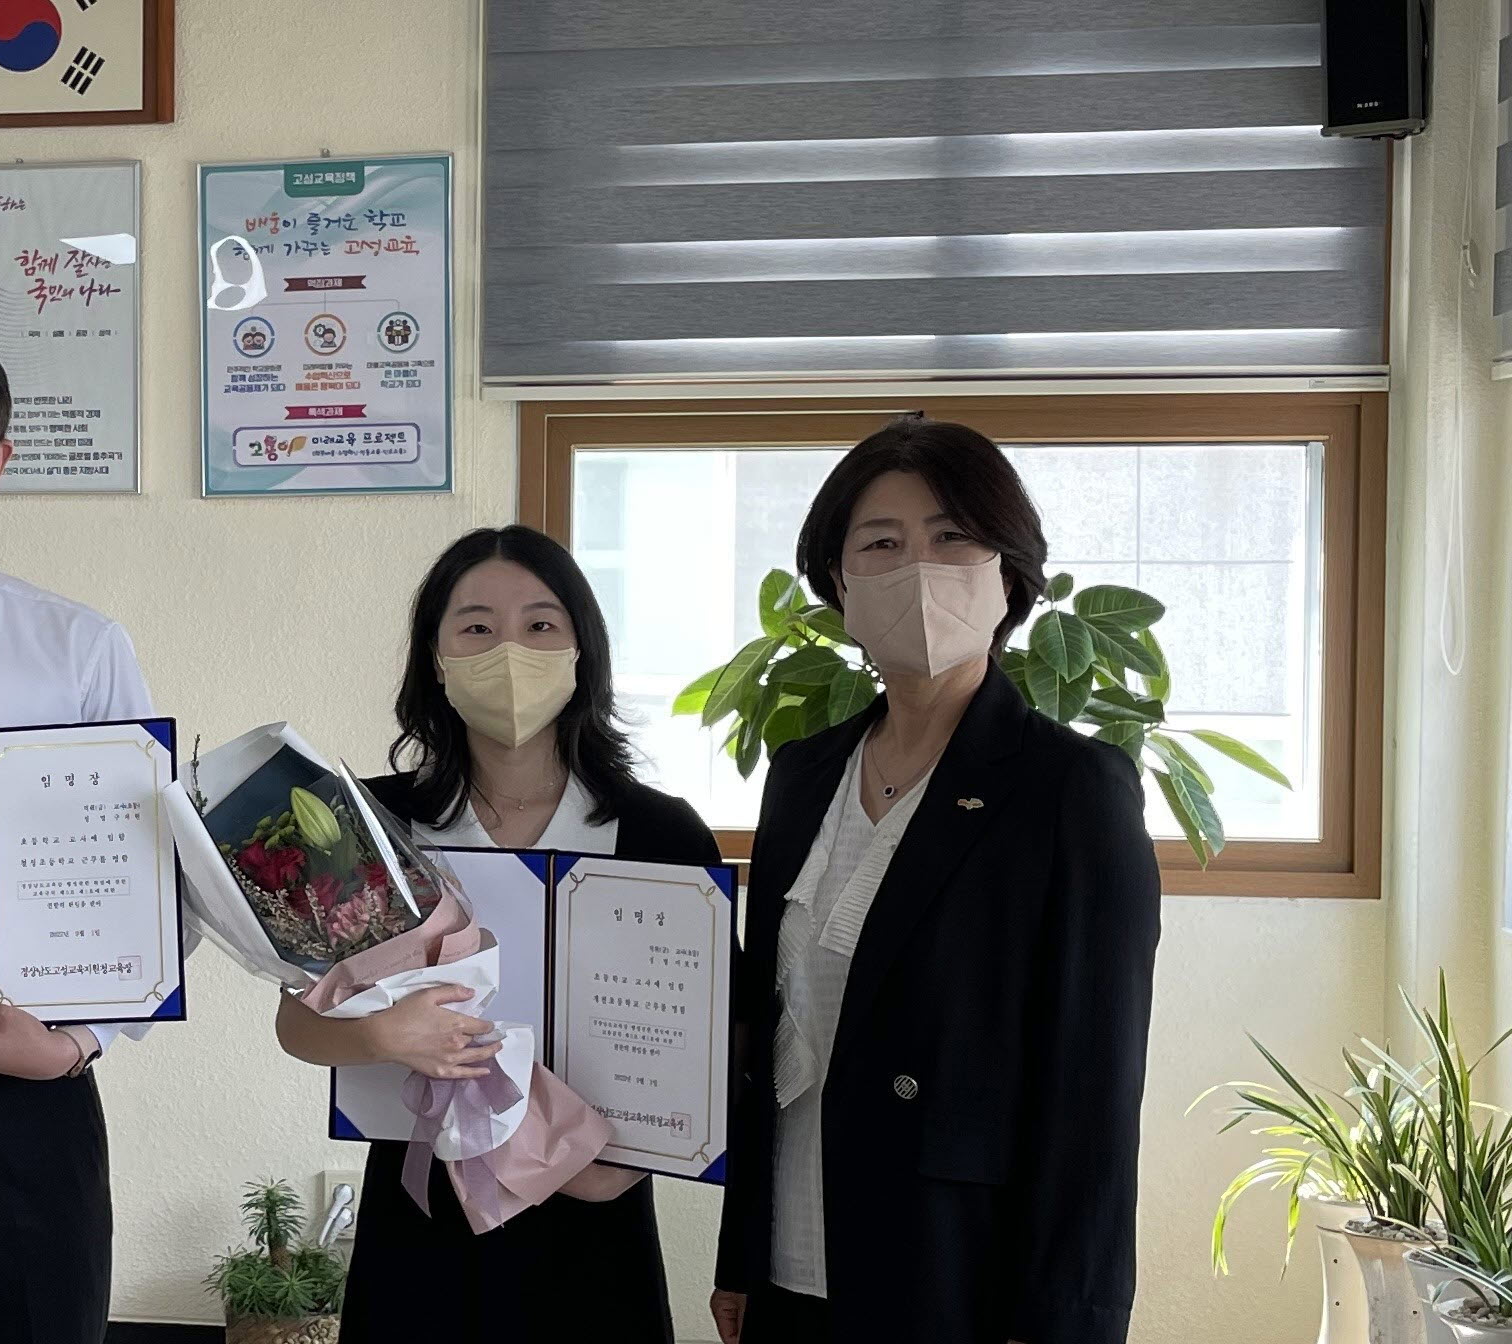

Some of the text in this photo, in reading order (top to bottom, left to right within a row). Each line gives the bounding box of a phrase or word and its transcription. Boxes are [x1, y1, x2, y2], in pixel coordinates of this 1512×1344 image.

[245, 209, 407, 235] 배움이 즐거운 학교
[284, 240, 331, 257] 가꾸는
[344, 235, 420, 256] 고성교육
[14, 249, 58, 276] 함께
[27, 278, 121, 314] 국민의 나라
[312, 432, 407, 446] 미래교육 프로젝트
